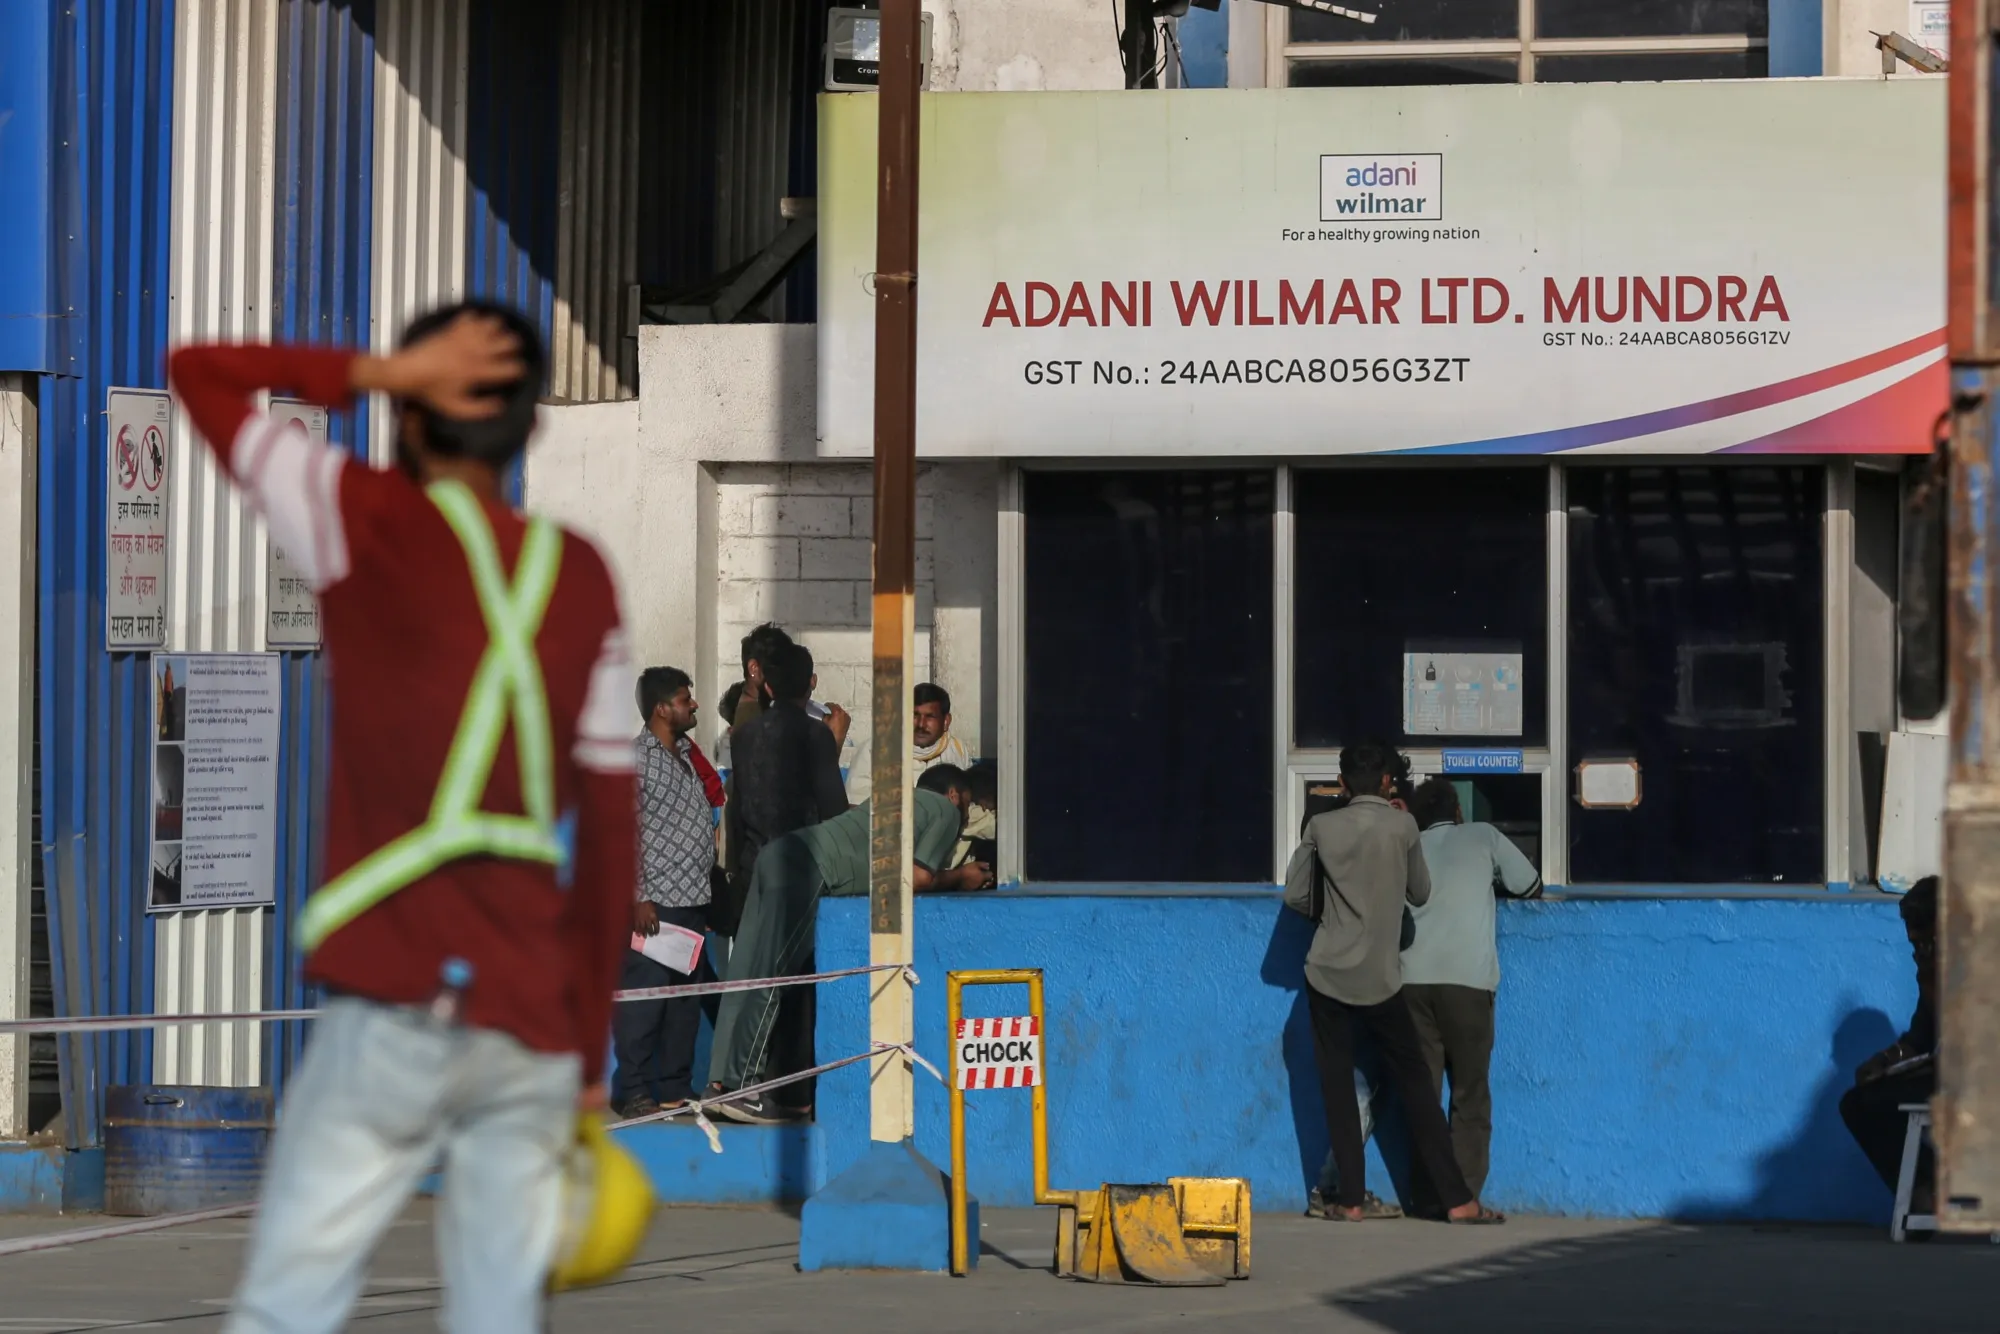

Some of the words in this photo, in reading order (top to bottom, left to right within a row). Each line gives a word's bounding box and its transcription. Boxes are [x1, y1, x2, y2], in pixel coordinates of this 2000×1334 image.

[1345, 161, 1417, 187] adani
[1336, 192, 1427, 214] wilmar
[1282, 228, 1306, 241] For
[1307, 230, 1316, 241] a
[1318, 228, 1371, 243] healthy
[1372, 227, 1430, 243] growing
[1433, 227, 1480, 240] nation
[982, 281, 1151, 327] ADANI
[1170, 278, 1401, 326] WILMAR
[1422, 278, 1524, 324] LTD.
[1543, 275, 1791, 323] MUNDRA
[1543, 333, 1576, 346] GST
[1581, 332, 1613, 346] No.:
[1619, 331, 1791, 346] 24AABCA8056G1ZV
[1024, 361, 1083, 384] GST
[1093, 360, 1149, 385] No.:
[1160, 357, 1471, 385] 24AABCA8056G3ZT
[1446, 755, 1476, 768] TOKEN
[1477, 755, 1519, 768] COUNTER
[962, 1041, 1034, 1064] CHOCK
